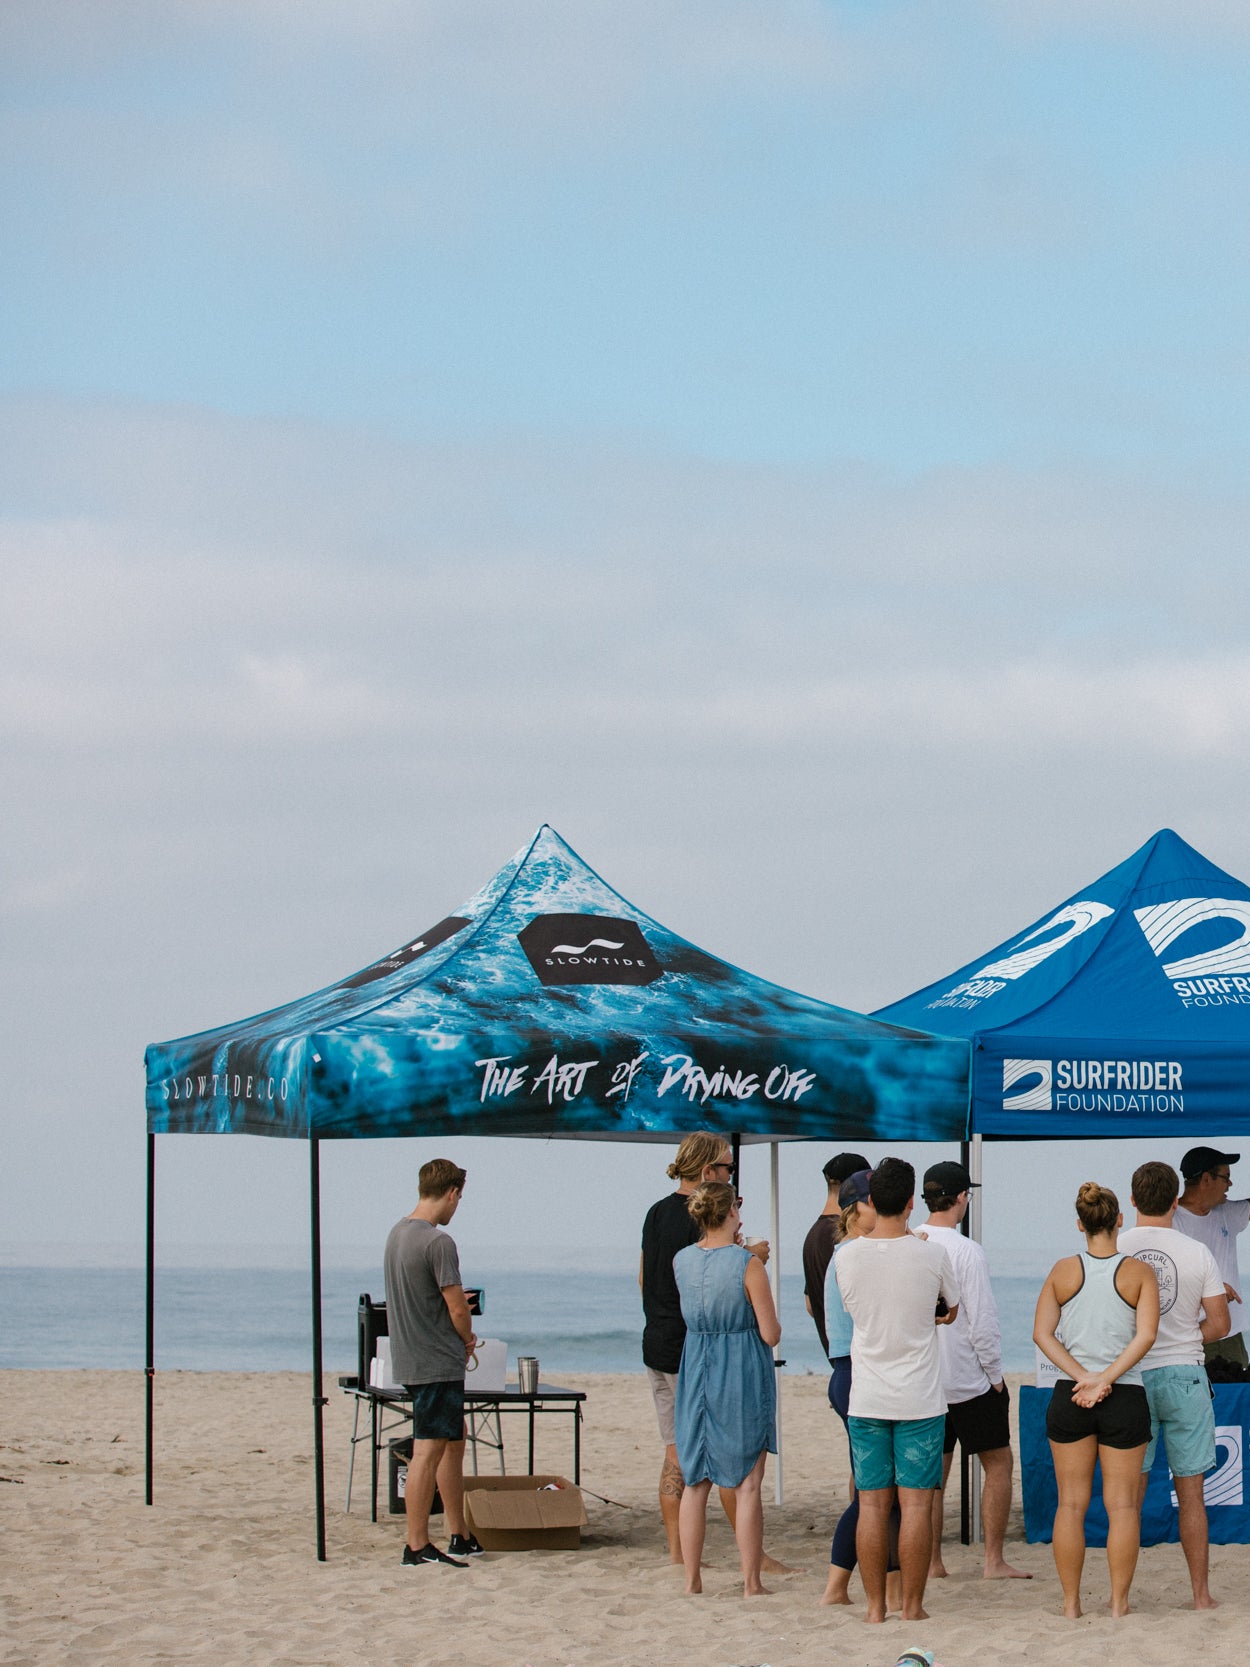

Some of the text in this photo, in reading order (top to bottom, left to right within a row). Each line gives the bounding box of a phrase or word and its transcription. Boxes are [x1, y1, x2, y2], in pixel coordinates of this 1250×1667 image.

[545, 957, 646, 967] SLOWTIDE
[160, 1074, 289, 1101] SLOWTIDE.CO
[475, 1055, 529, 1104] THE
[530, 1054, 600, 1105] ART
[1057, 1060, 1183, 1091] SURFRIDER
[1056, 1093, 1184, 1112] FOUNDATION
